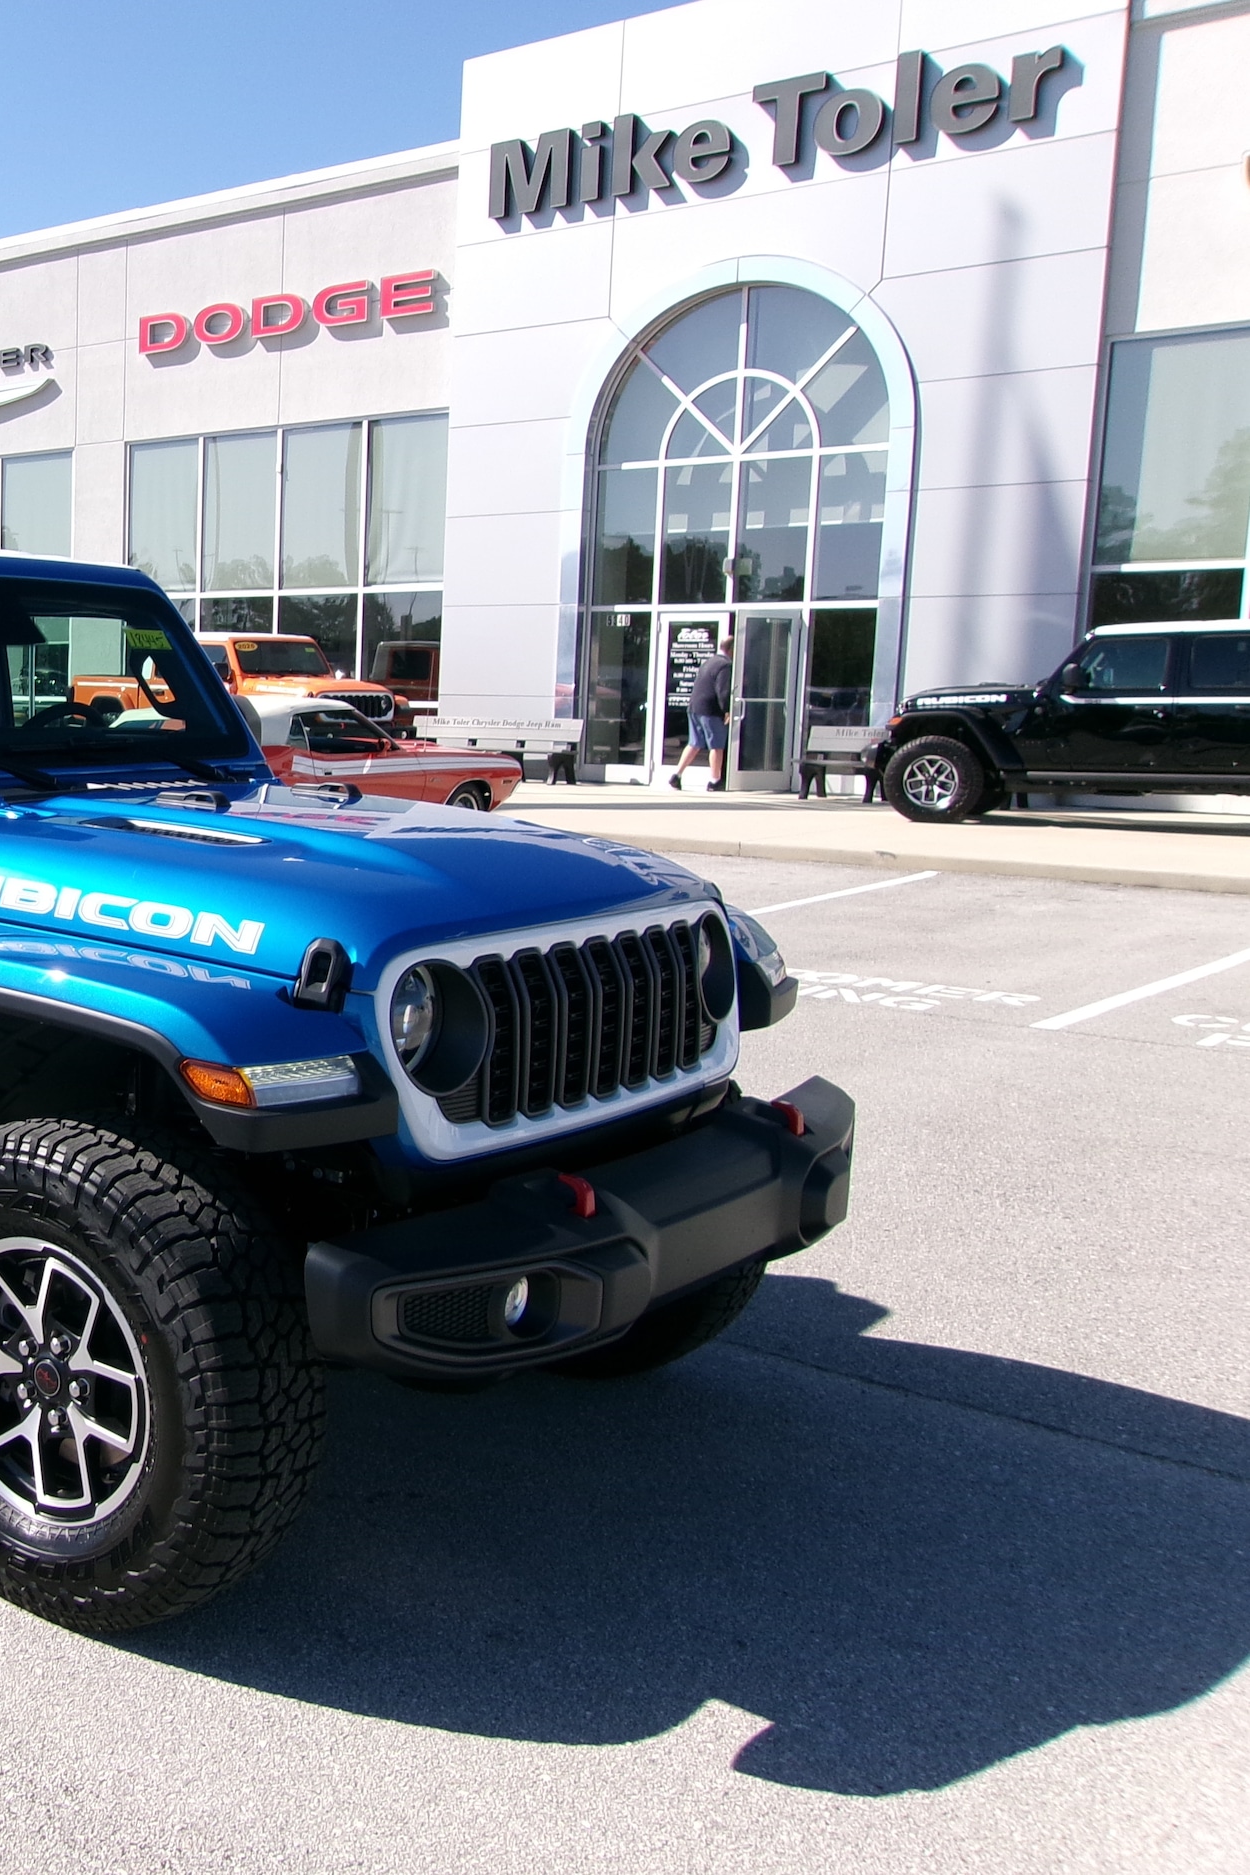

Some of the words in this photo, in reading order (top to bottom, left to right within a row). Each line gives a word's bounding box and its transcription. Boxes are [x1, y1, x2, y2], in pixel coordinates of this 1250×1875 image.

[488, 114, 733, 220] Mike
[752, 45, 1066, 167] Toler
[138, 268, 440, 357] DODGE
[432, 717, 451, 726] Mike
[452, 718, 470, 726] Toler
[471, 718, 501, 728] Chrysler
[502, 719, 525, 729] Dodge
[525, 720, 543, 730] Jeep
[544, 721, 562, 729] Ram
[835, 728, 859, 737] Mike
